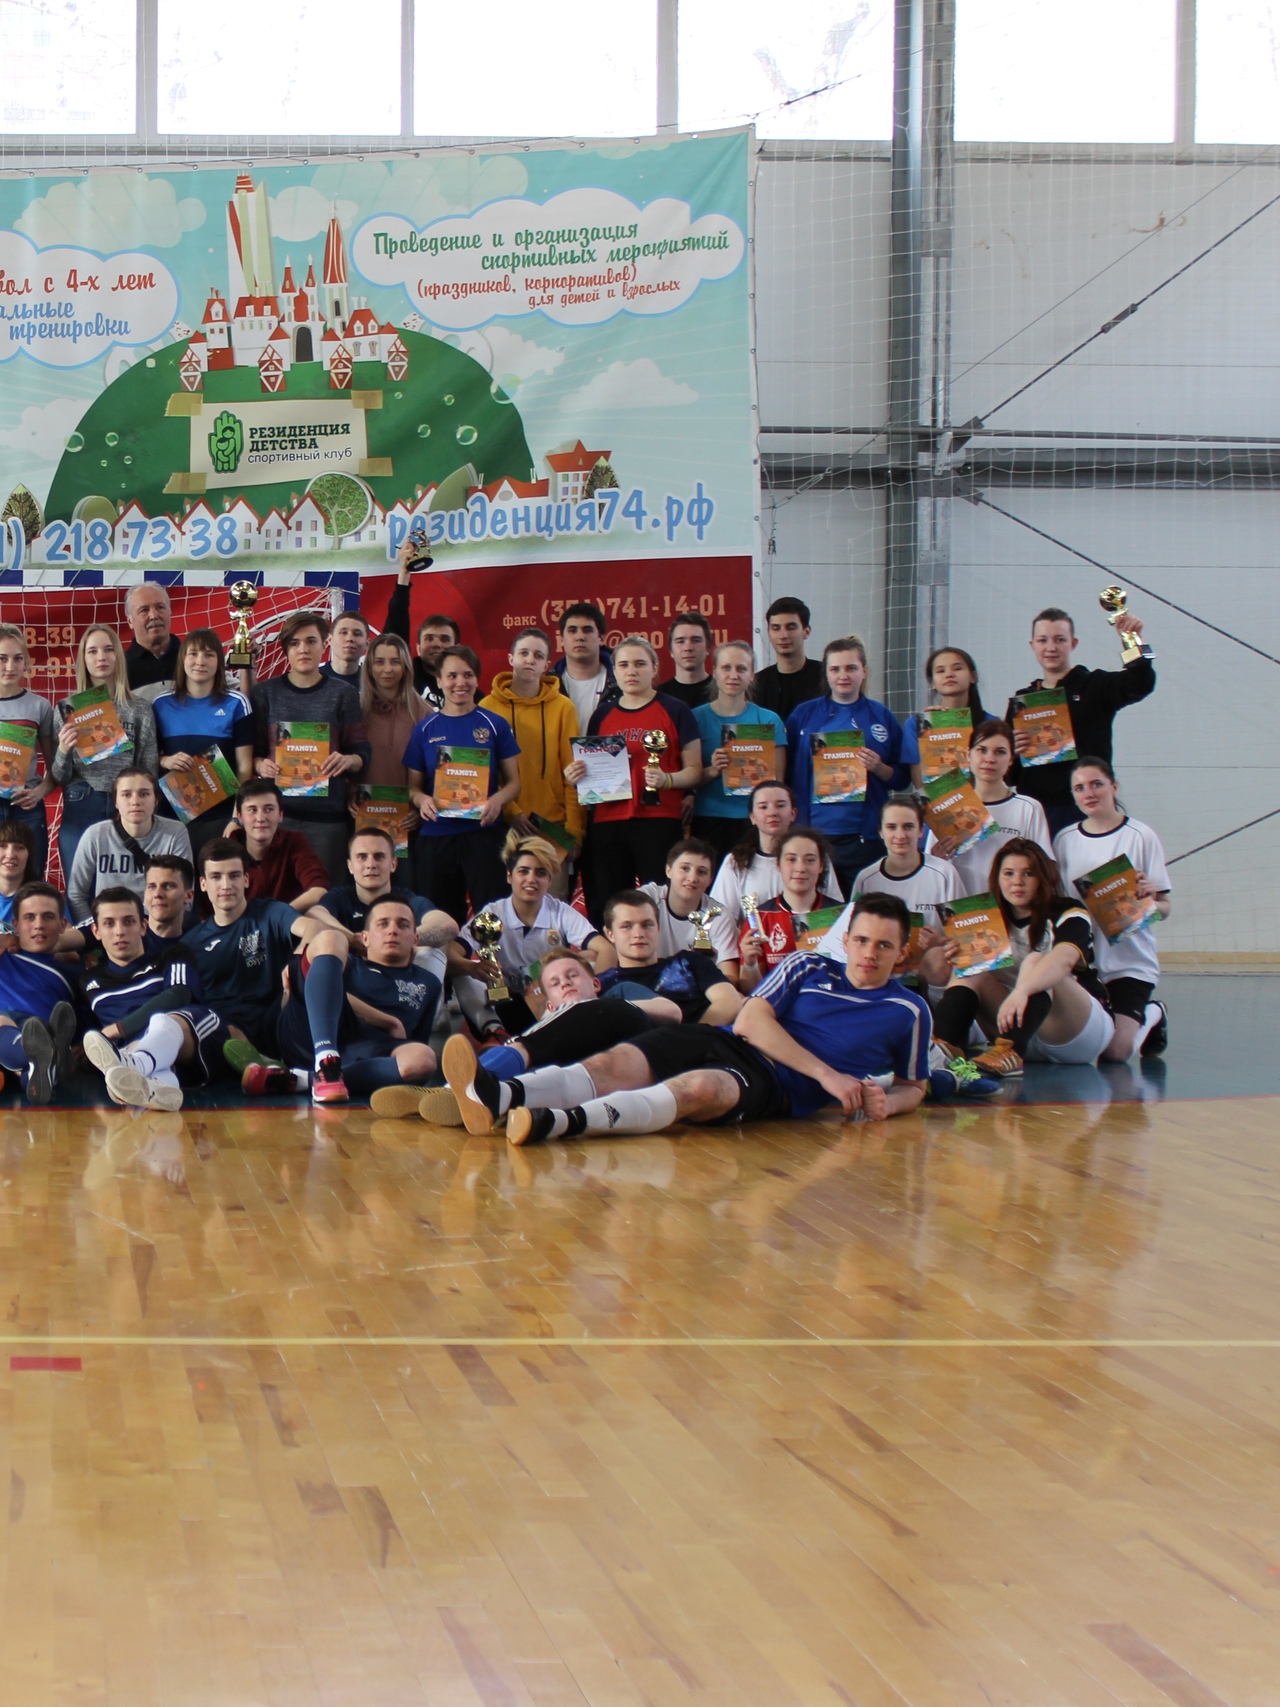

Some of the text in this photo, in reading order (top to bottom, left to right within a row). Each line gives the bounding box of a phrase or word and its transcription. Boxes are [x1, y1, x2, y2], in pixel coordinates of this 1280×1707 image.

[373, 223, 638, 259] Проведение и организация
[481, 231, 730, 273] спортивных мероприятий
[44, 277, 55, 294] с
[66, 269, 100, 292] 4-х
[111, 272, 156, 292] лет
[417, 263, 637, 301] (праздников, корпоративов)
[528, 280, 681, 309] для детей и взрослых
[9, 312, 131, 344] тренировки
[249, 424, 351, 439] РЕЗИДЕНЦИЯ
[249, 438, 319, 453] ДЕТСТВА
[248, 447, 352, 464] спортивный клуб
[44, 519, 112, 563] 218
[127, 519, 172, 561] 73
[189, 516, 239, 558] 38
[502, 613, 537, 629] факс
[74, 708, 104, 725] ГРАМОТА
[1023, 709, 1057, 721] ГРАМОТА
[928, 731, 962, 742] ГРАМОТА
[286, 744, 318, 753] ГРАМОТА
[731, 745, 764, 753] ГРАМОТА
[823, 752, 856, 760] ГРАМОТА
[198, 764, 218, 794] ГРАМОТА
[446, 768, 478, 777] ГРАМОТА
[366, 805, 398, 814] ГРАМОТА
[931, 793, 964, 814] ГРАМОТА
[99, 854, 130, 874] OLD
[1094, 877, 1128, 898] ГРАМОТА
[954, 914, 990, 928] ГРАМОТА
